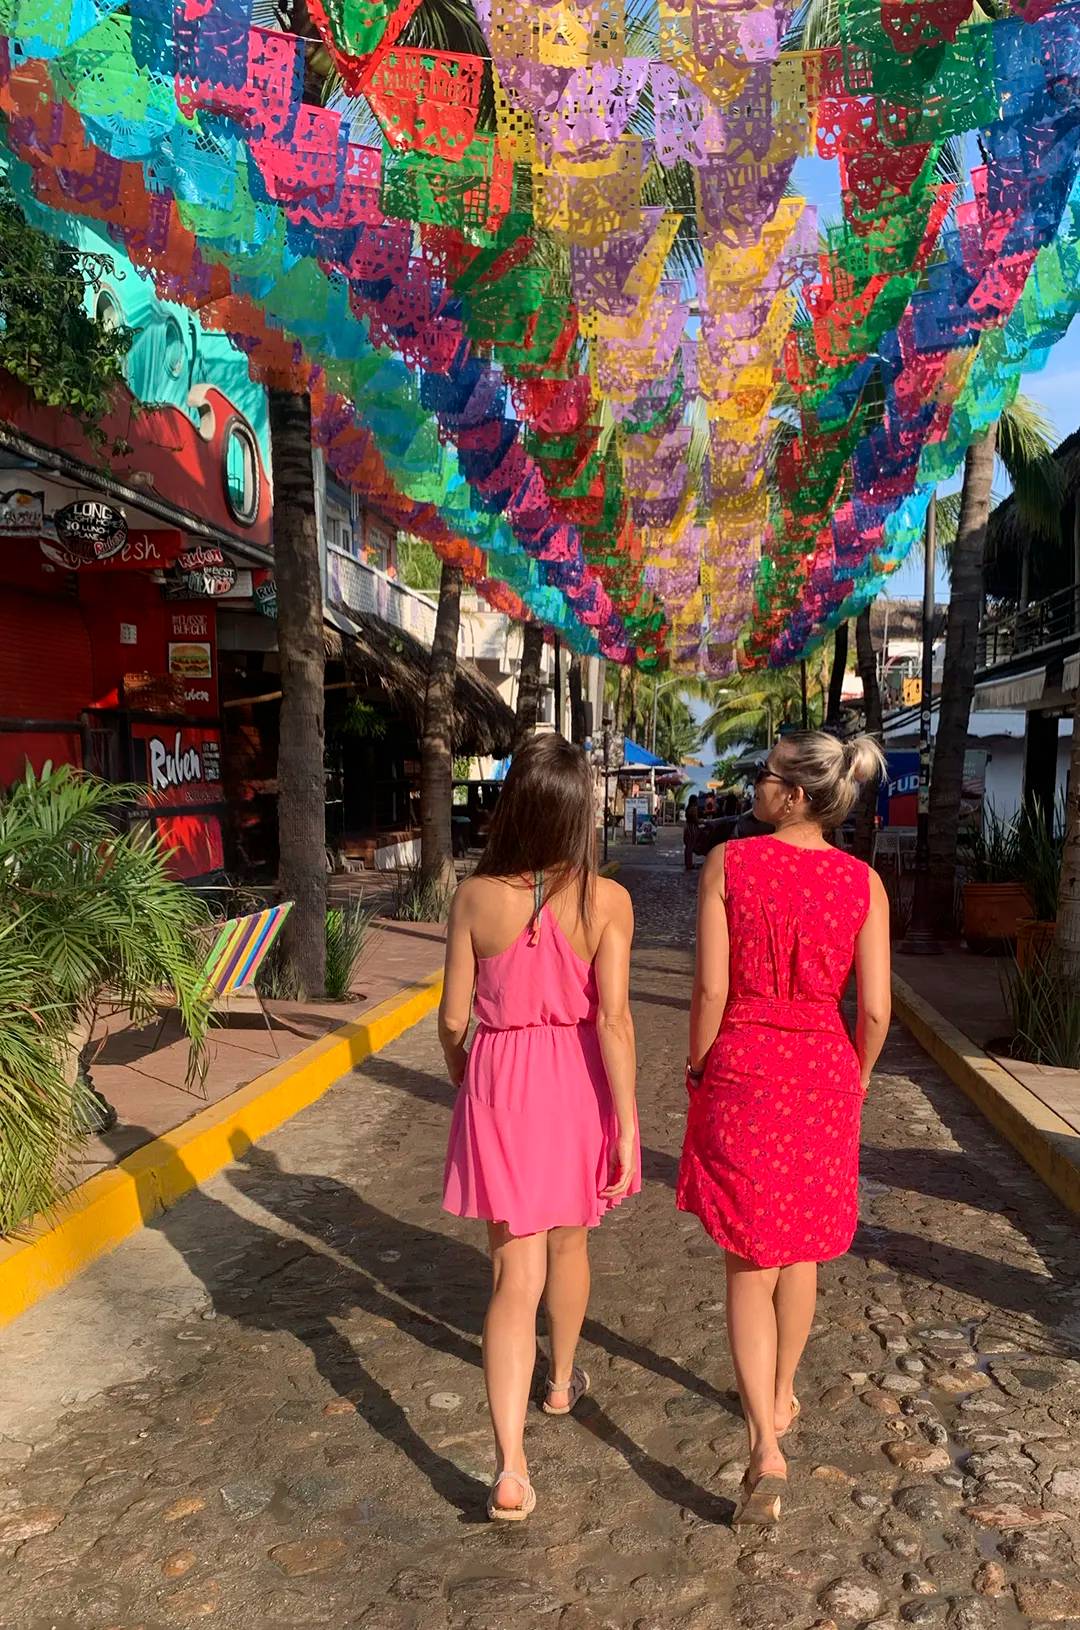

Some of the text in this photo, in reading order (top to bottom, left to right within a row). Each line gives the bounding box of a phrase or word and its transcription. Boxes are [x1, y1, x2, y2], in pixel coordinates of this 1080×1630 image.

[73, 502, 113, 520] LONG
[177, 546, 224, 569] Ruben
[184, 688, 210, 703] uben
[149, 730, 201, 792] Ruben
[889, 775, 920, 797] FUD
